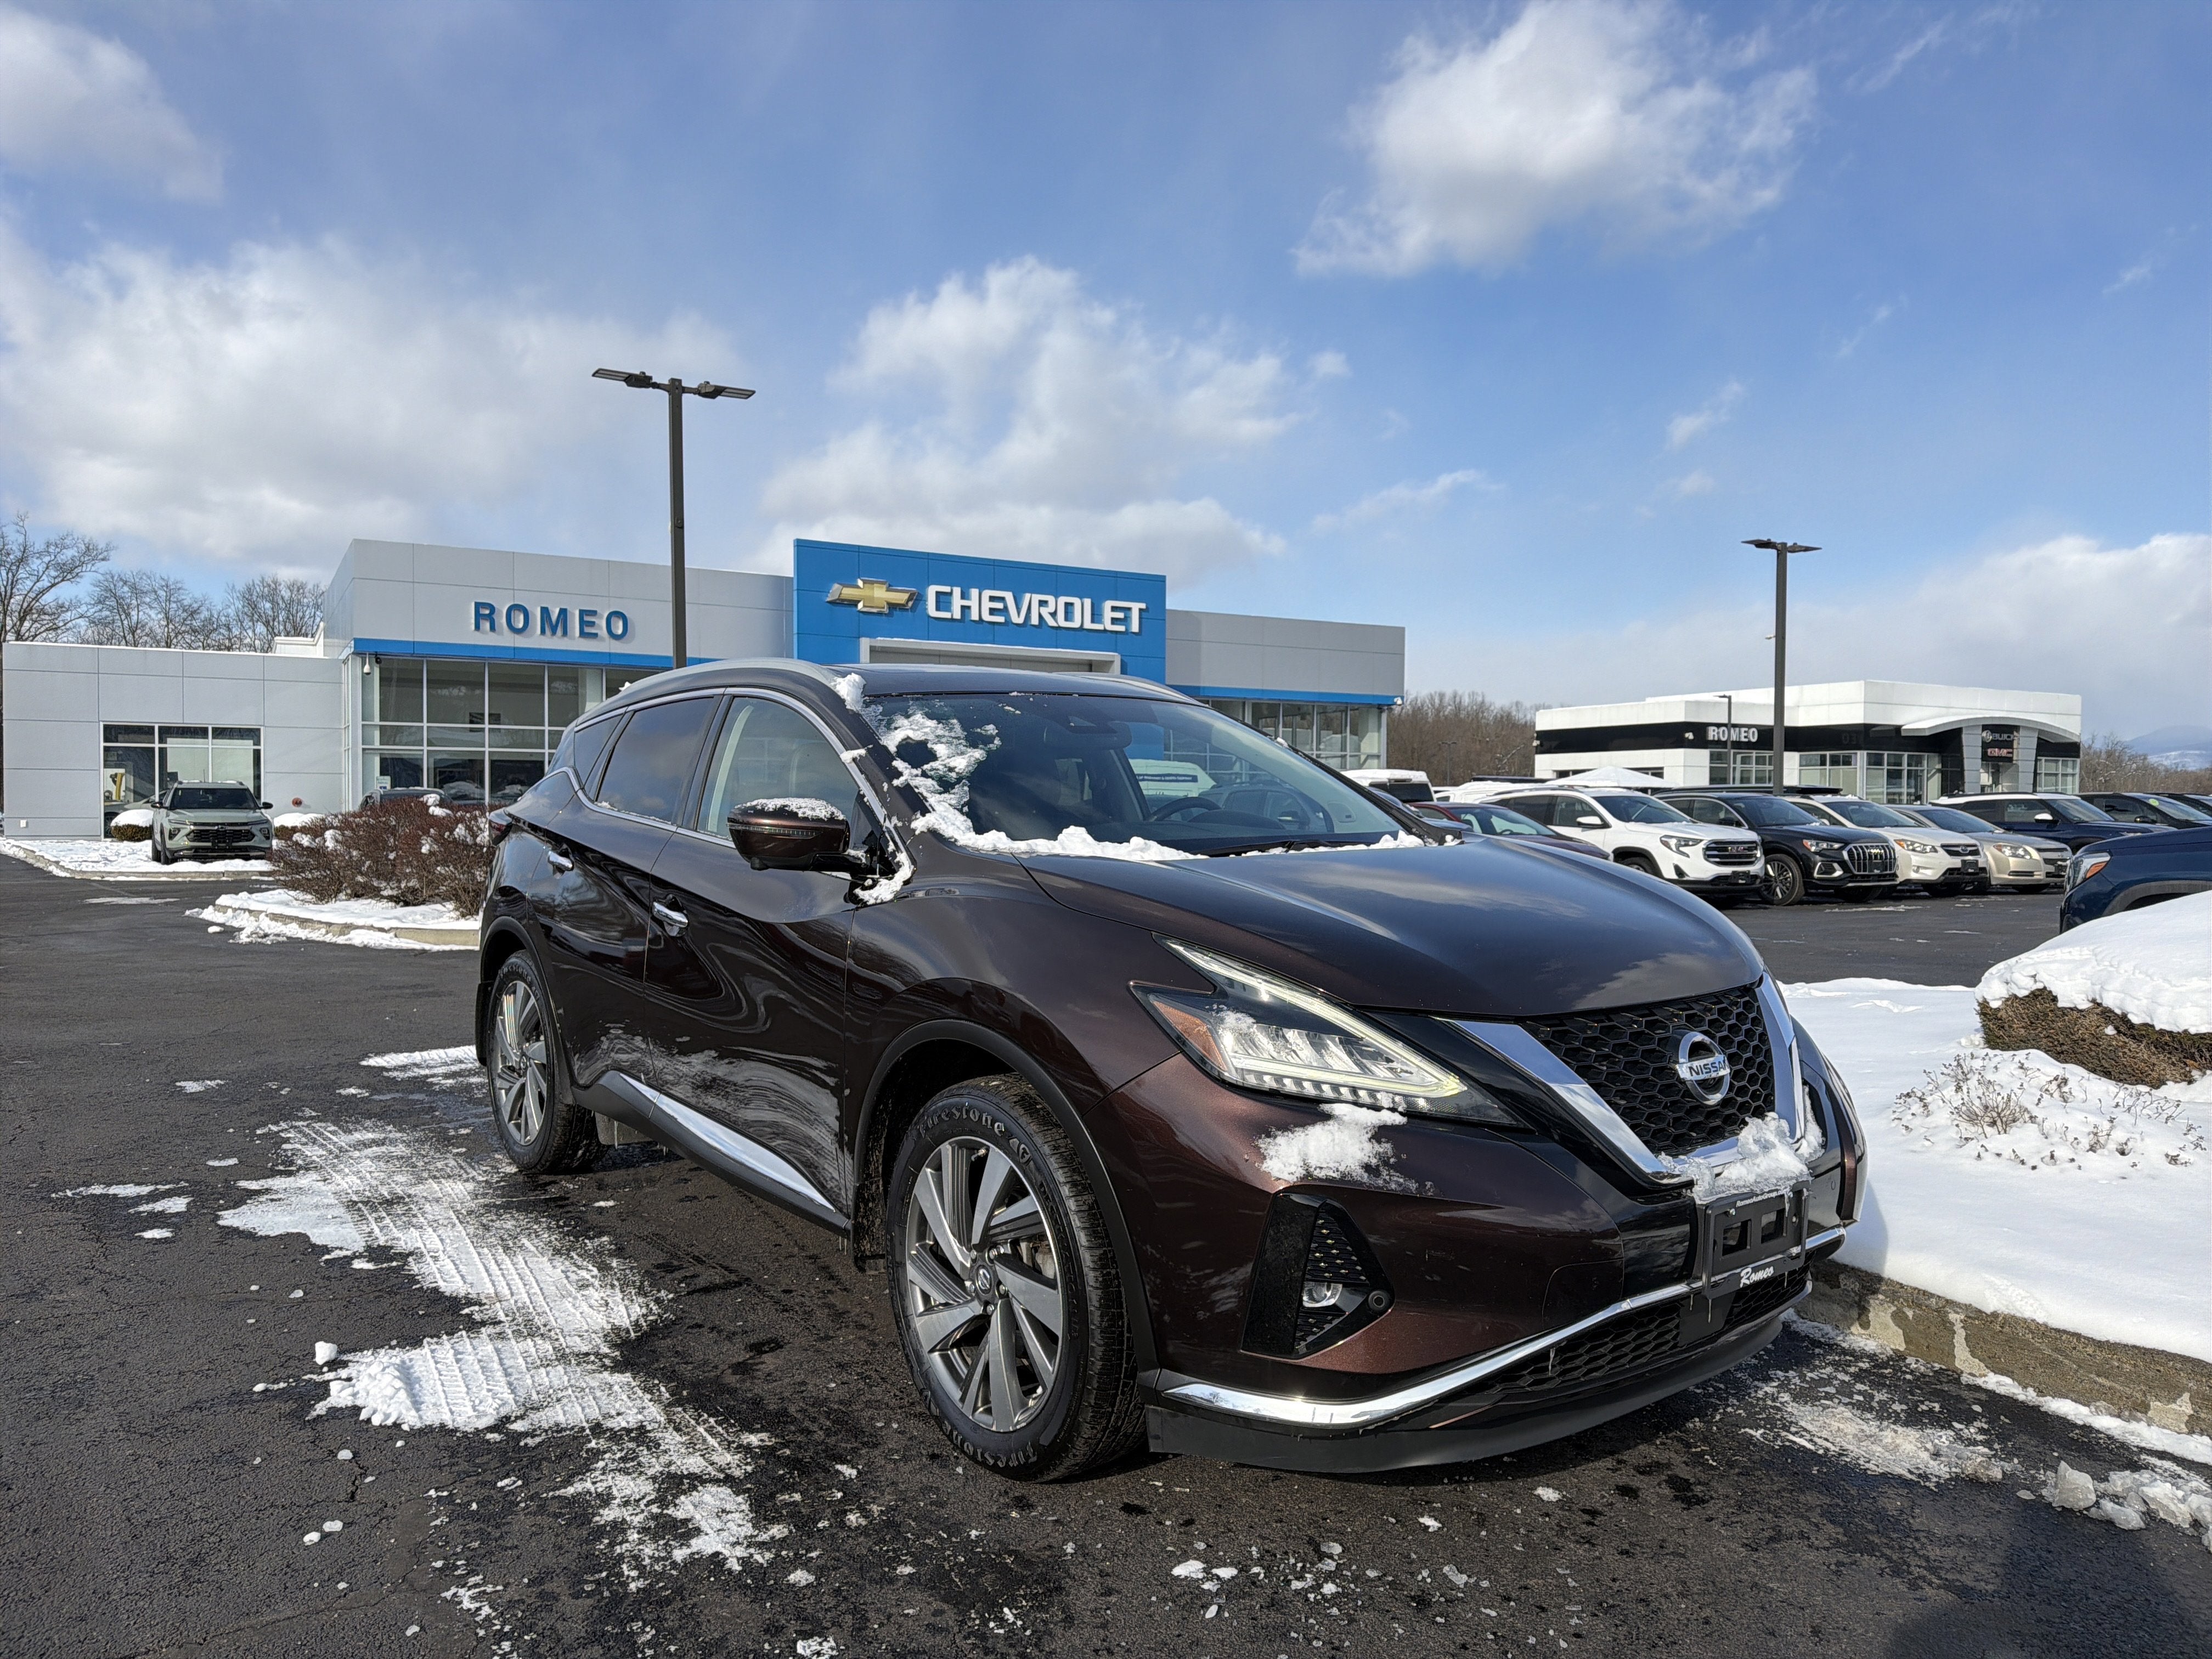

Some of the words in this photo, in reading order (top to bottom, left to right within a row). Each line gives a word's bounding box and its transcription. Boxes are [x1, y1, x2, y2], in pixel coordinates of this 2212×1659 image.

[927, 585, 1147, 633] CHEVROLET
[473, 601, 629, 640] ROMEO
[1707, 726, 1758, 742] ROMEO
[1988, 748, 2013, 757] GMC
[1740, 1266, 1774, 1288] Romeo
